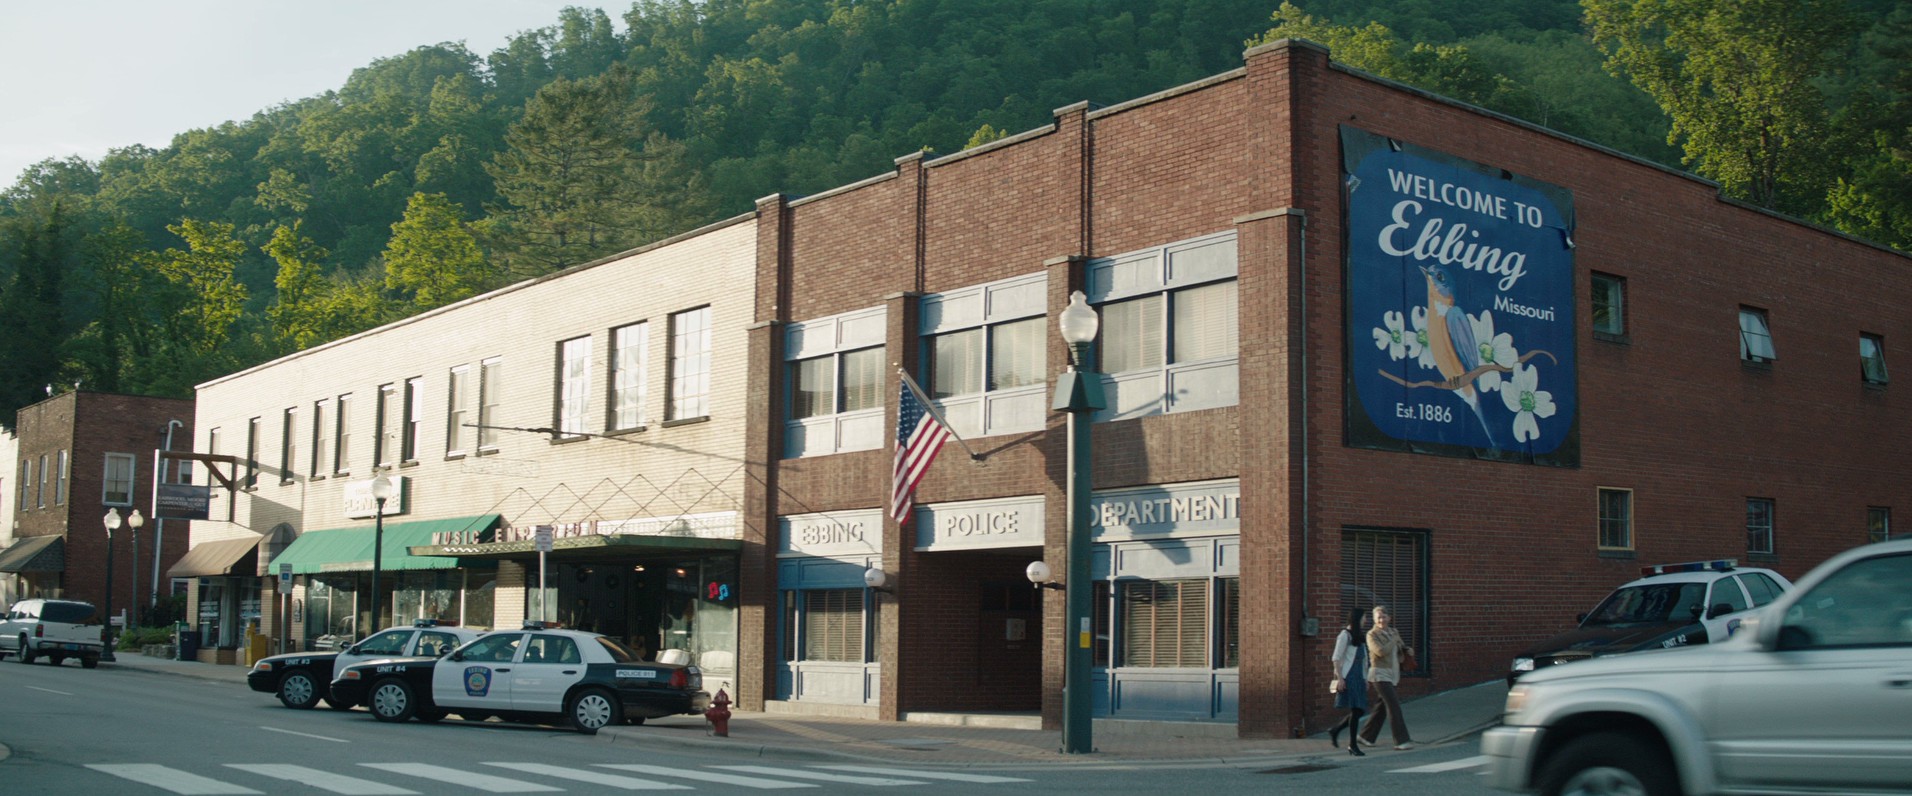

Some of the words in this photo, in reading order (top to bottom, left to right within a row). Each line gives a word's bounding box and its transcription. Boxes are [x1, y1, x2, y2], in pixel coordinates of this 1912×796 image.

[1388, 168, 1507, 219] WELCOME
[1514, 201, 1543, 228] TO
[1378, 200, 1527, 291] Ebbing
[1494, 295, 1555, 321] Missouri
[1396, 403, 1416, 420] Est.
[1418, 404, 1452, 423] 1886
[432, 530, 480, 546] MUSIC
[495, 520, 599, 543] EMPRIUM
[803, 522, 864, 545] EBBING
[948, 511, 1019, 537] POLICE
[1662, 637, 1678, 649] UNIT
[1678, 634, 1687, 643] #2
[376, 665, 393, 673] UNIT
